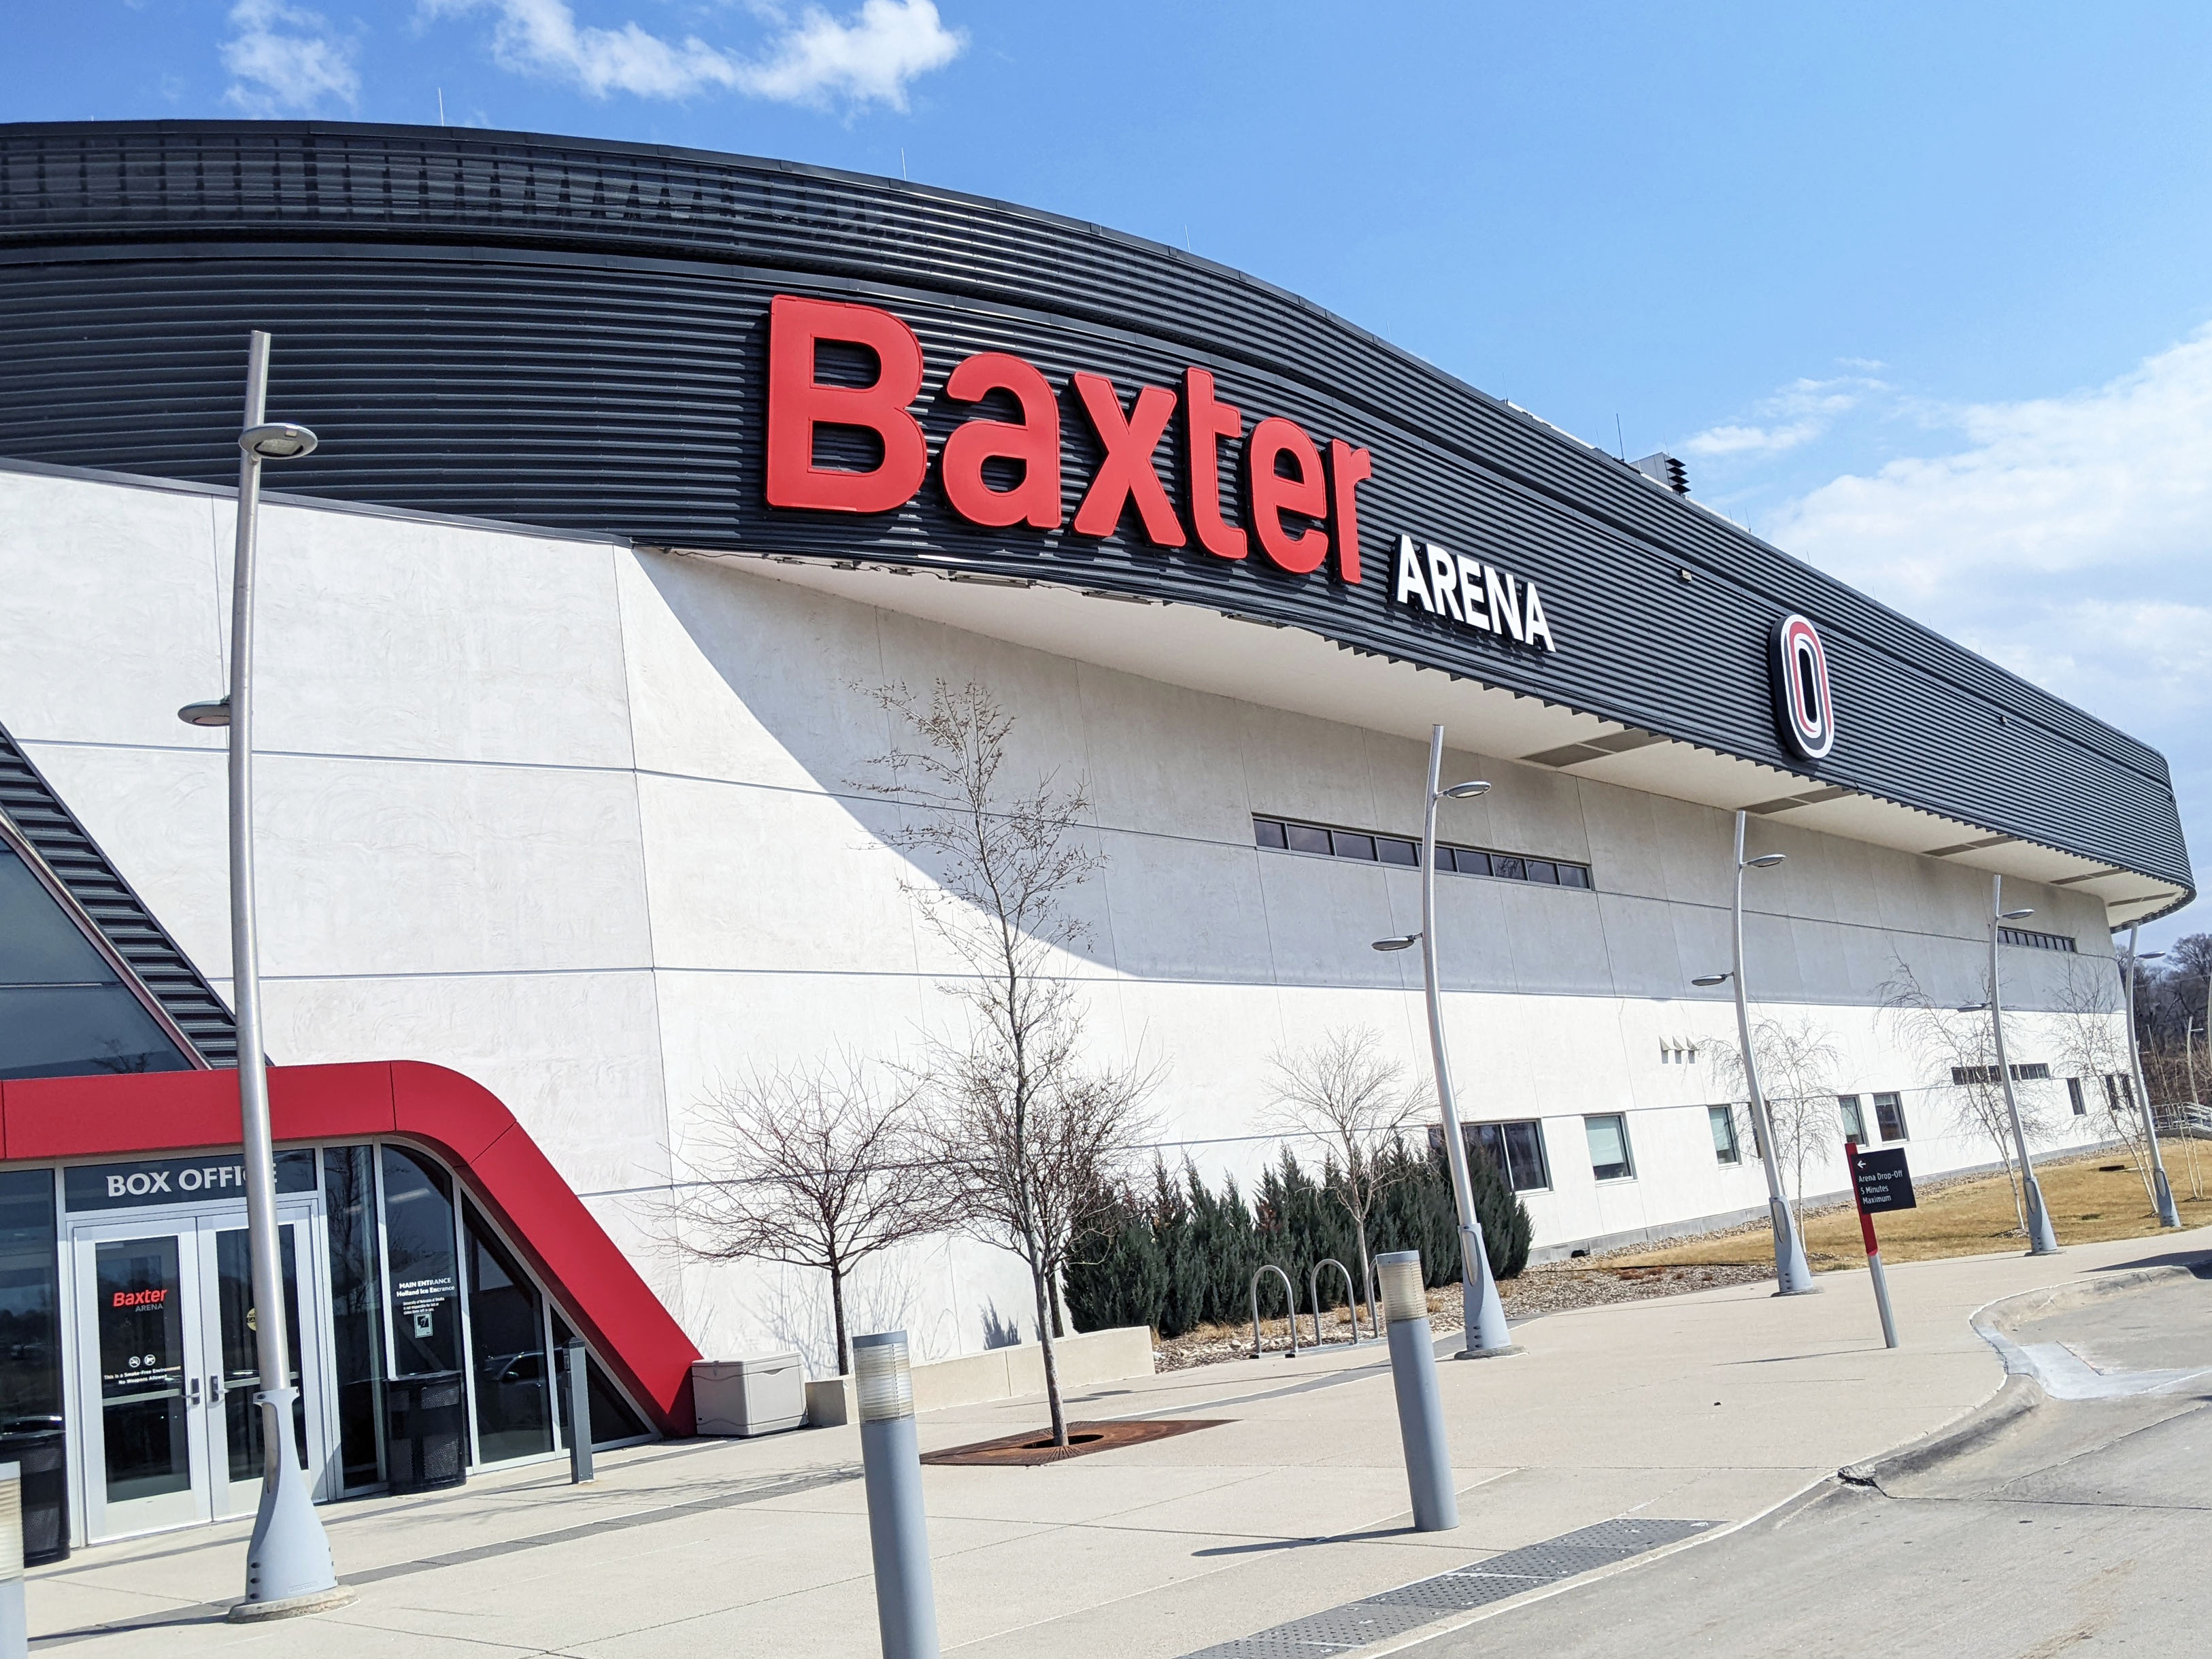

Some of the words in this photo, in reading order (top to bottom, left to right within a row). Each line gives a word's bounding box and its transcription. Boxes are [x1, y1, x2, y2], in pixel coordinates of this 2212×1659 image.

[766, 293, 1371, 585] Baxter
[1396, 533, 1556, 653] ARENA
[106, 1171, 173, 1197] BOX
[178, 1162, 278, 1191] OFFI
[1859, 1175, 1876, 1183] Arena
[1877, 1169, 1903, 1181] Drop-Off
[1860, 1187, 1865, 1195] 5
[1865, 1185, 1889, 1194] Minutes
[1862, 1195, 1892, 1205] Maximum
[399, 1281, 417, 1289] MAIN
[417, 1277, 452, 1287] ENTRANCE
[113, 1289, 167, 1307] Baxter
[396, 1289, 420, 1297] Holland
[135, 1303, 164, 1312] ARENA
